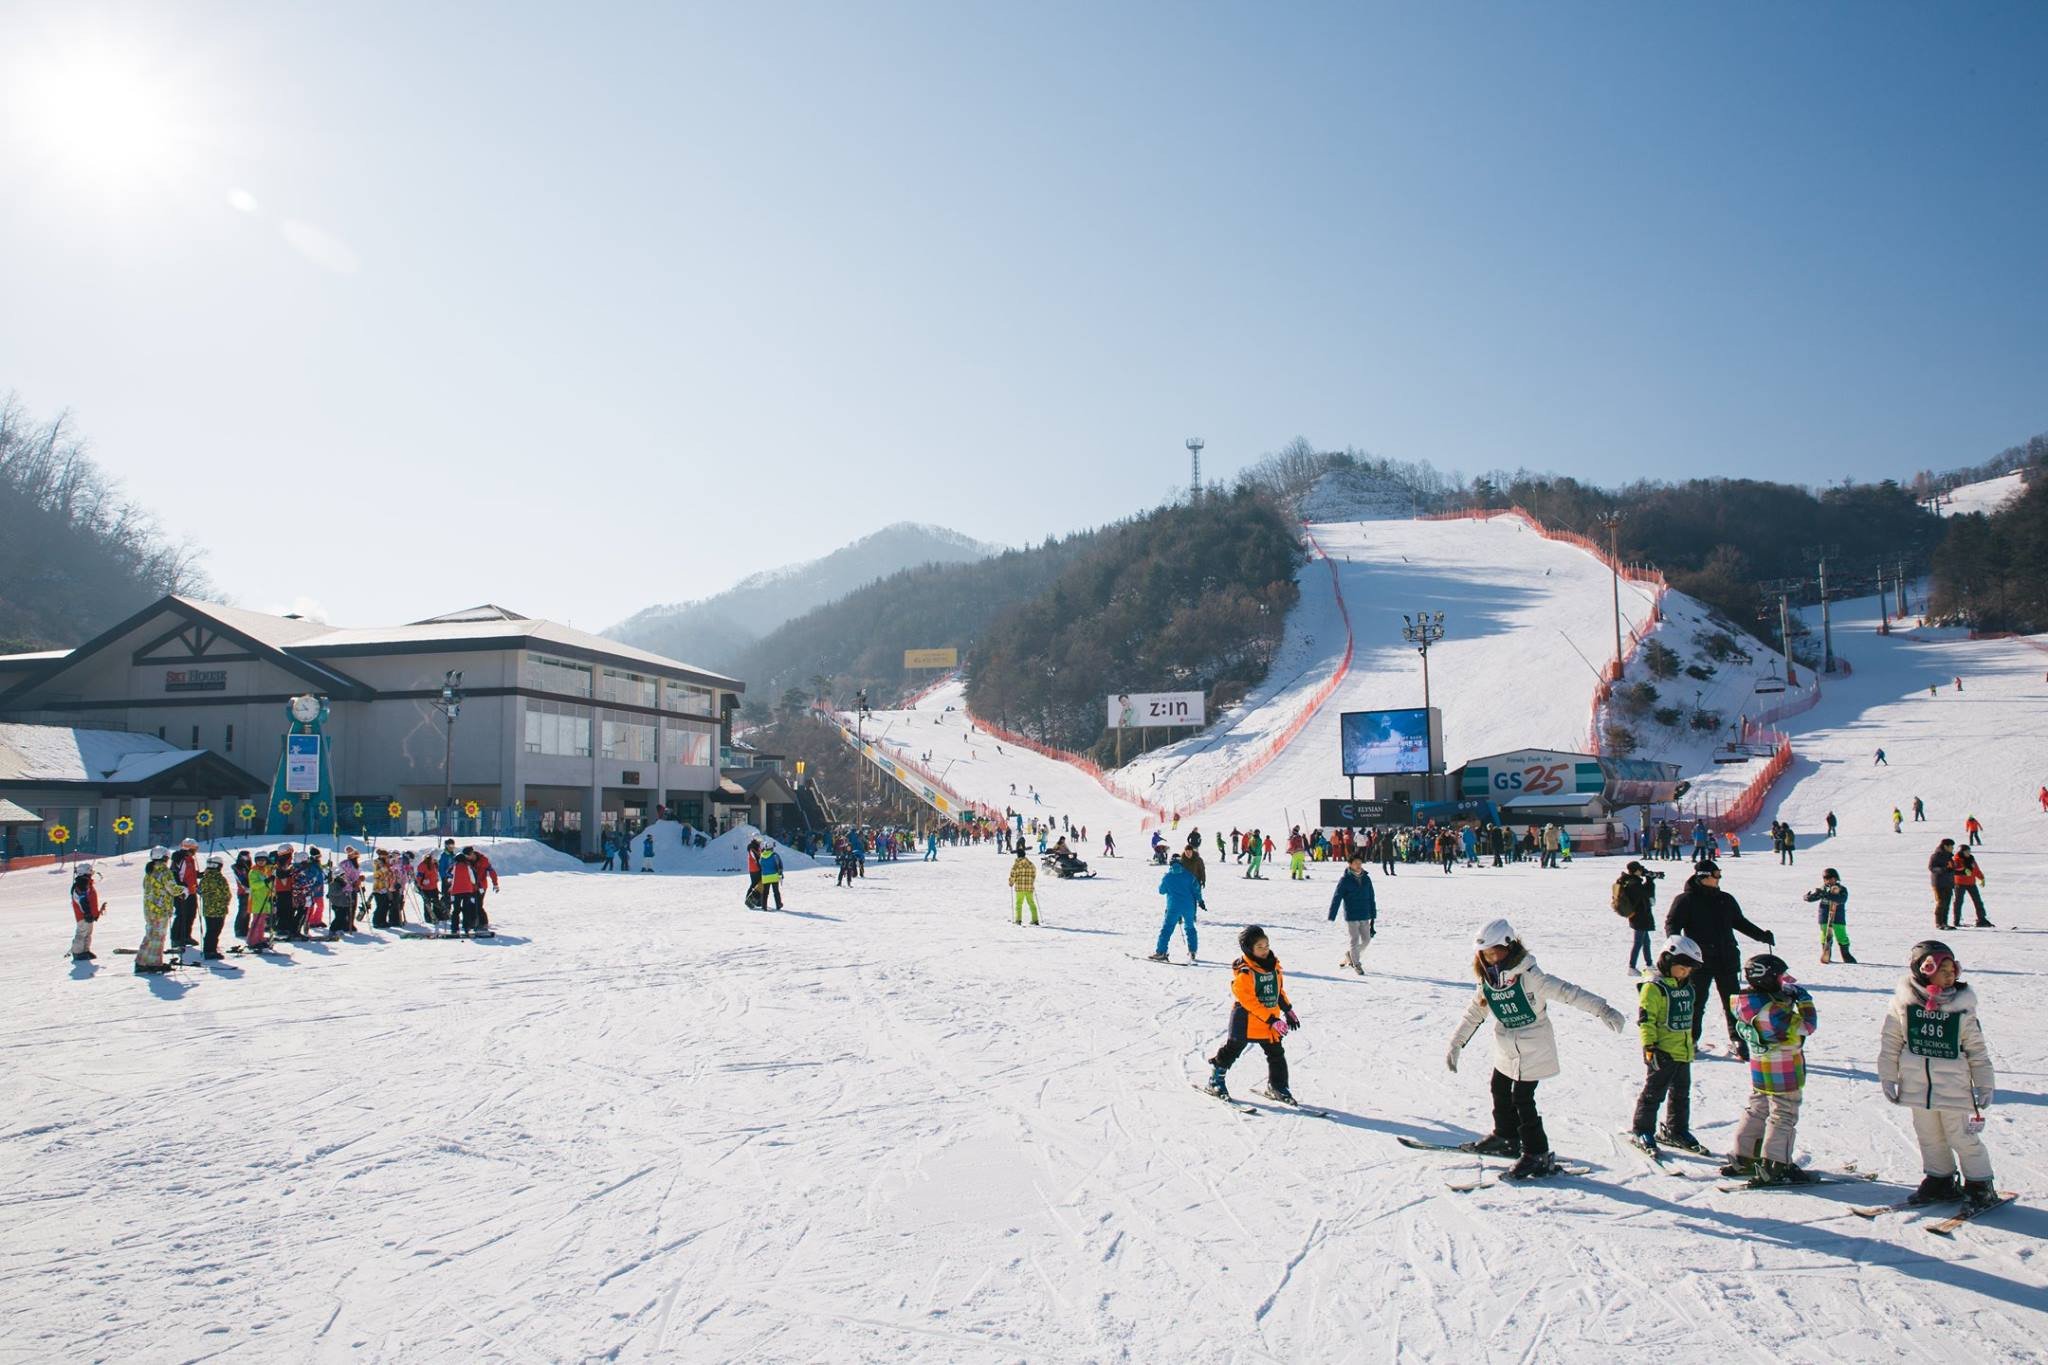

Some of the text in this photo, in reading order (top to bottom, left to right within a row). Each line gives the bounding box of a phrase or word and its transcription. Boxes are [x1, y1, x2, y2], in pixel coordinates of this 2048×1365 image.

[1491, 990, 1515, 1000] GROUP
[1500, 1003, 1518, 1014] 308
[1915, 1009, 1950, 1021] GROUP
[1920, 1023, 1943, 1038] 496
